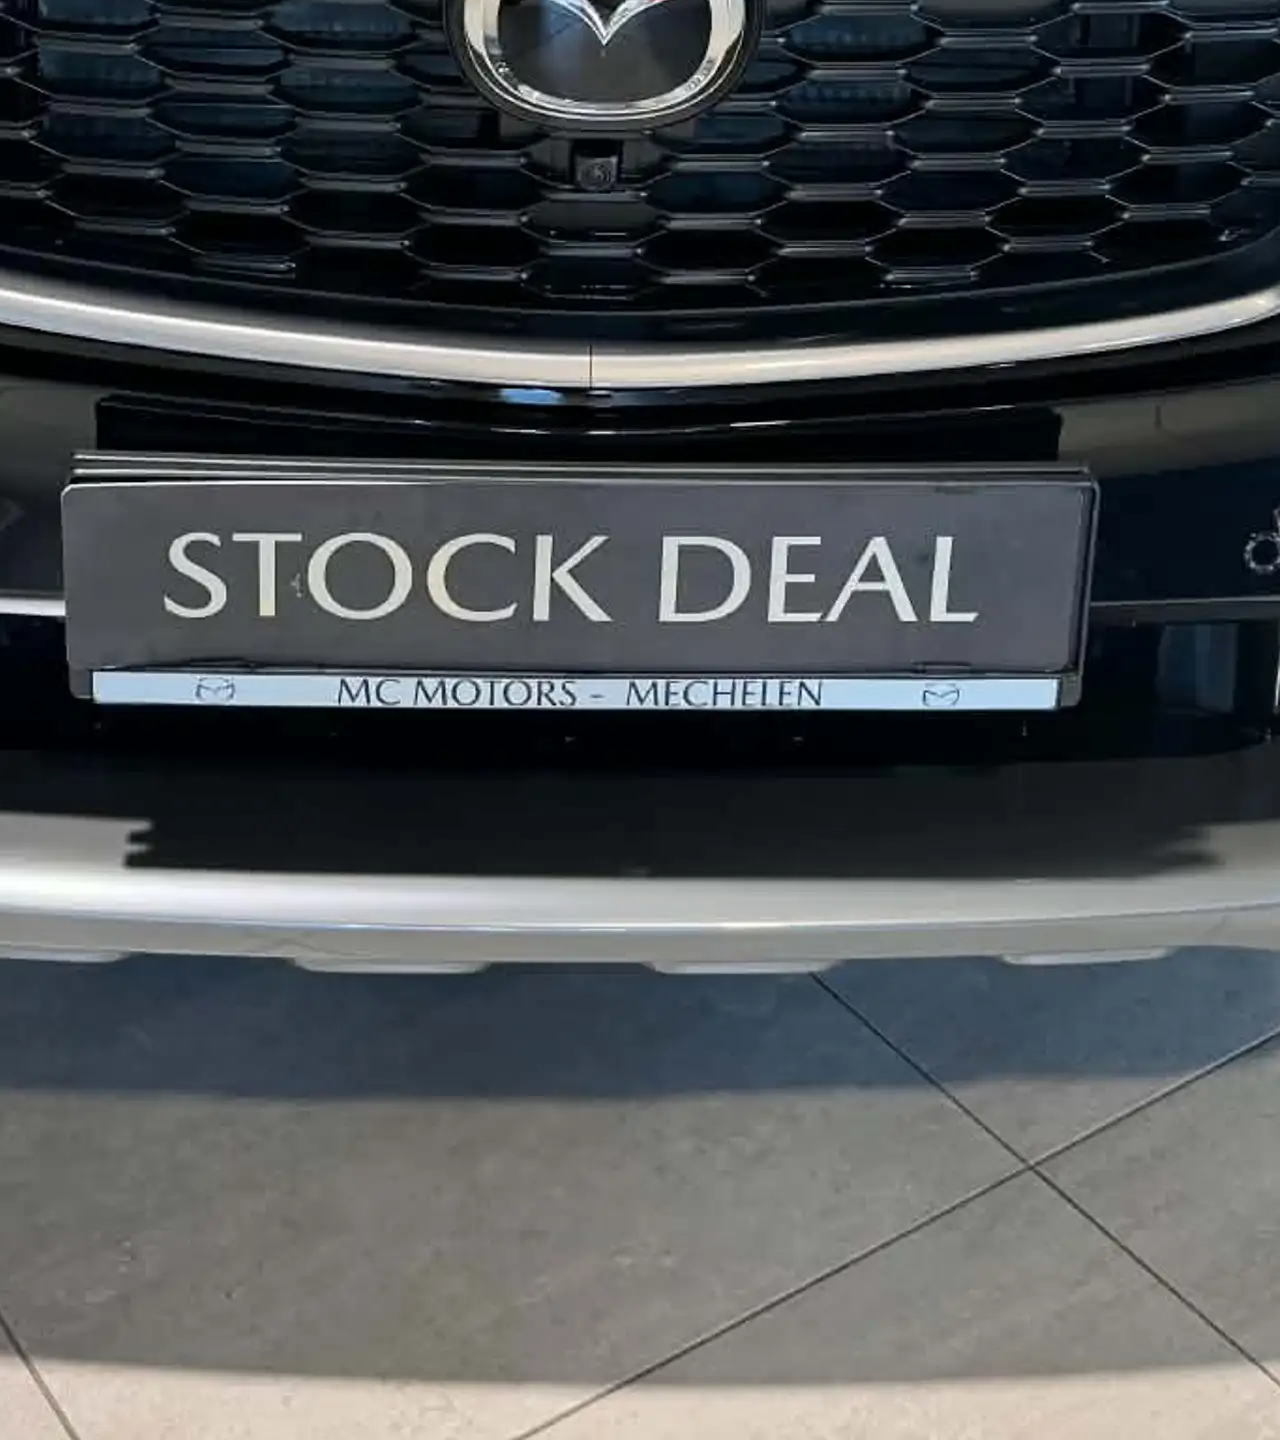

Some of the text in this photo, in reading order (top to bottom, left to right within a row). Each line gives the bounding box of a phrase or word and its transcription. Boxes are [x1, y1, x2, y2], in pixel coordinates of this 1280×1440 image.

[163, 532, 979, 623] STOCK DEAL
[337, 678, 401, 706] MC
[413, 678, 578, 707] MOTORS
[625, 679, 823, 707] MECHELEN
